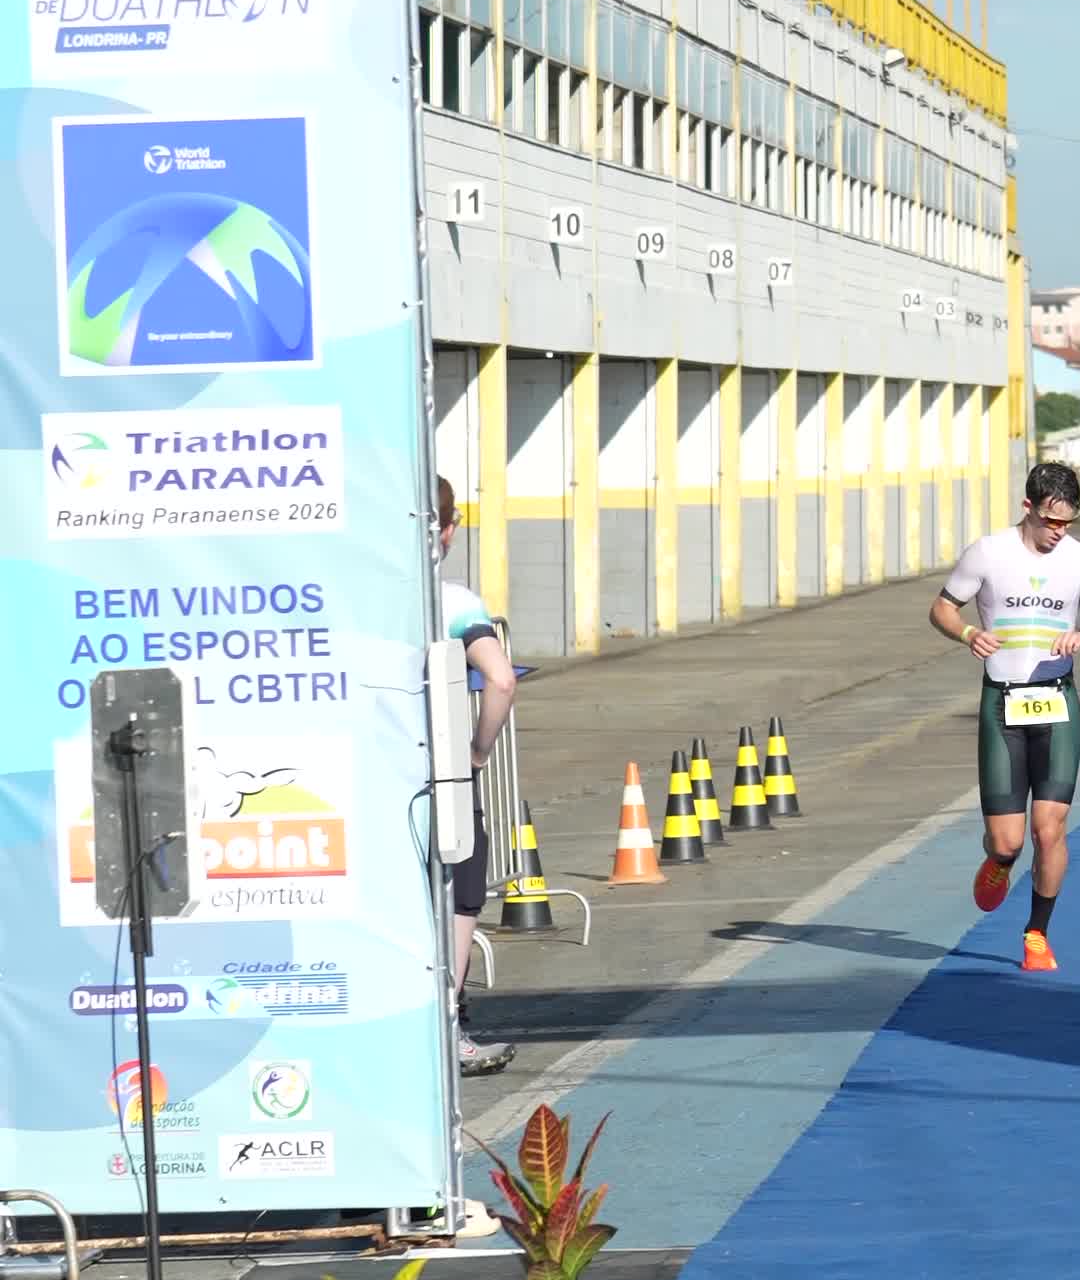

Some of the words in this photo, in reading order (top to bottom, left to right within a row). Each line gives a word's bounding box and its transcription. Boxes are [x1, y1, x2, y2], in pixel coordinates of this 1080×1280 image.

[35, 0, 59, 14] DE
[174, 146, 210, 158] World
[175, 158, 226, 170] Triathlon
[453, 188, 480, 215] 11
[551, 213, 581, 236] 10
[637, 232, 665, 253] 09
[708, 249, 734, 269] 08
[768, 262, 792, 281] 07
[902, 293, 921, 308] 04
[936, 302, 954, 316] 03
[126, 429, 328, 454] Triathlon
[128, 460, 325, 492] PARANÁ
[56, 508, 144, 529] Ranking
[152, 506, 280, 525] Paranaense
[288, 503, 337, 520] 2026
[74, 588, 160, 619] BEM
[172, 583, 325, 617] VINDOS
[70, 634, 128, 664] AO
[143, 628, 331, 662] ESPORTE
[228, 672, 348, 705] CBTRI
[1022, 700, 1052, 714] 161
[212, 883, 326, 912] esportiva
[223, 961, 302, 974] Cidade
[310, 960, 337, 971] de
[136, 1098, 195, 1115] Fndação
[153, 1114, 200, 1130] sportes
[261, 1140, 325, 1157] ACLR
